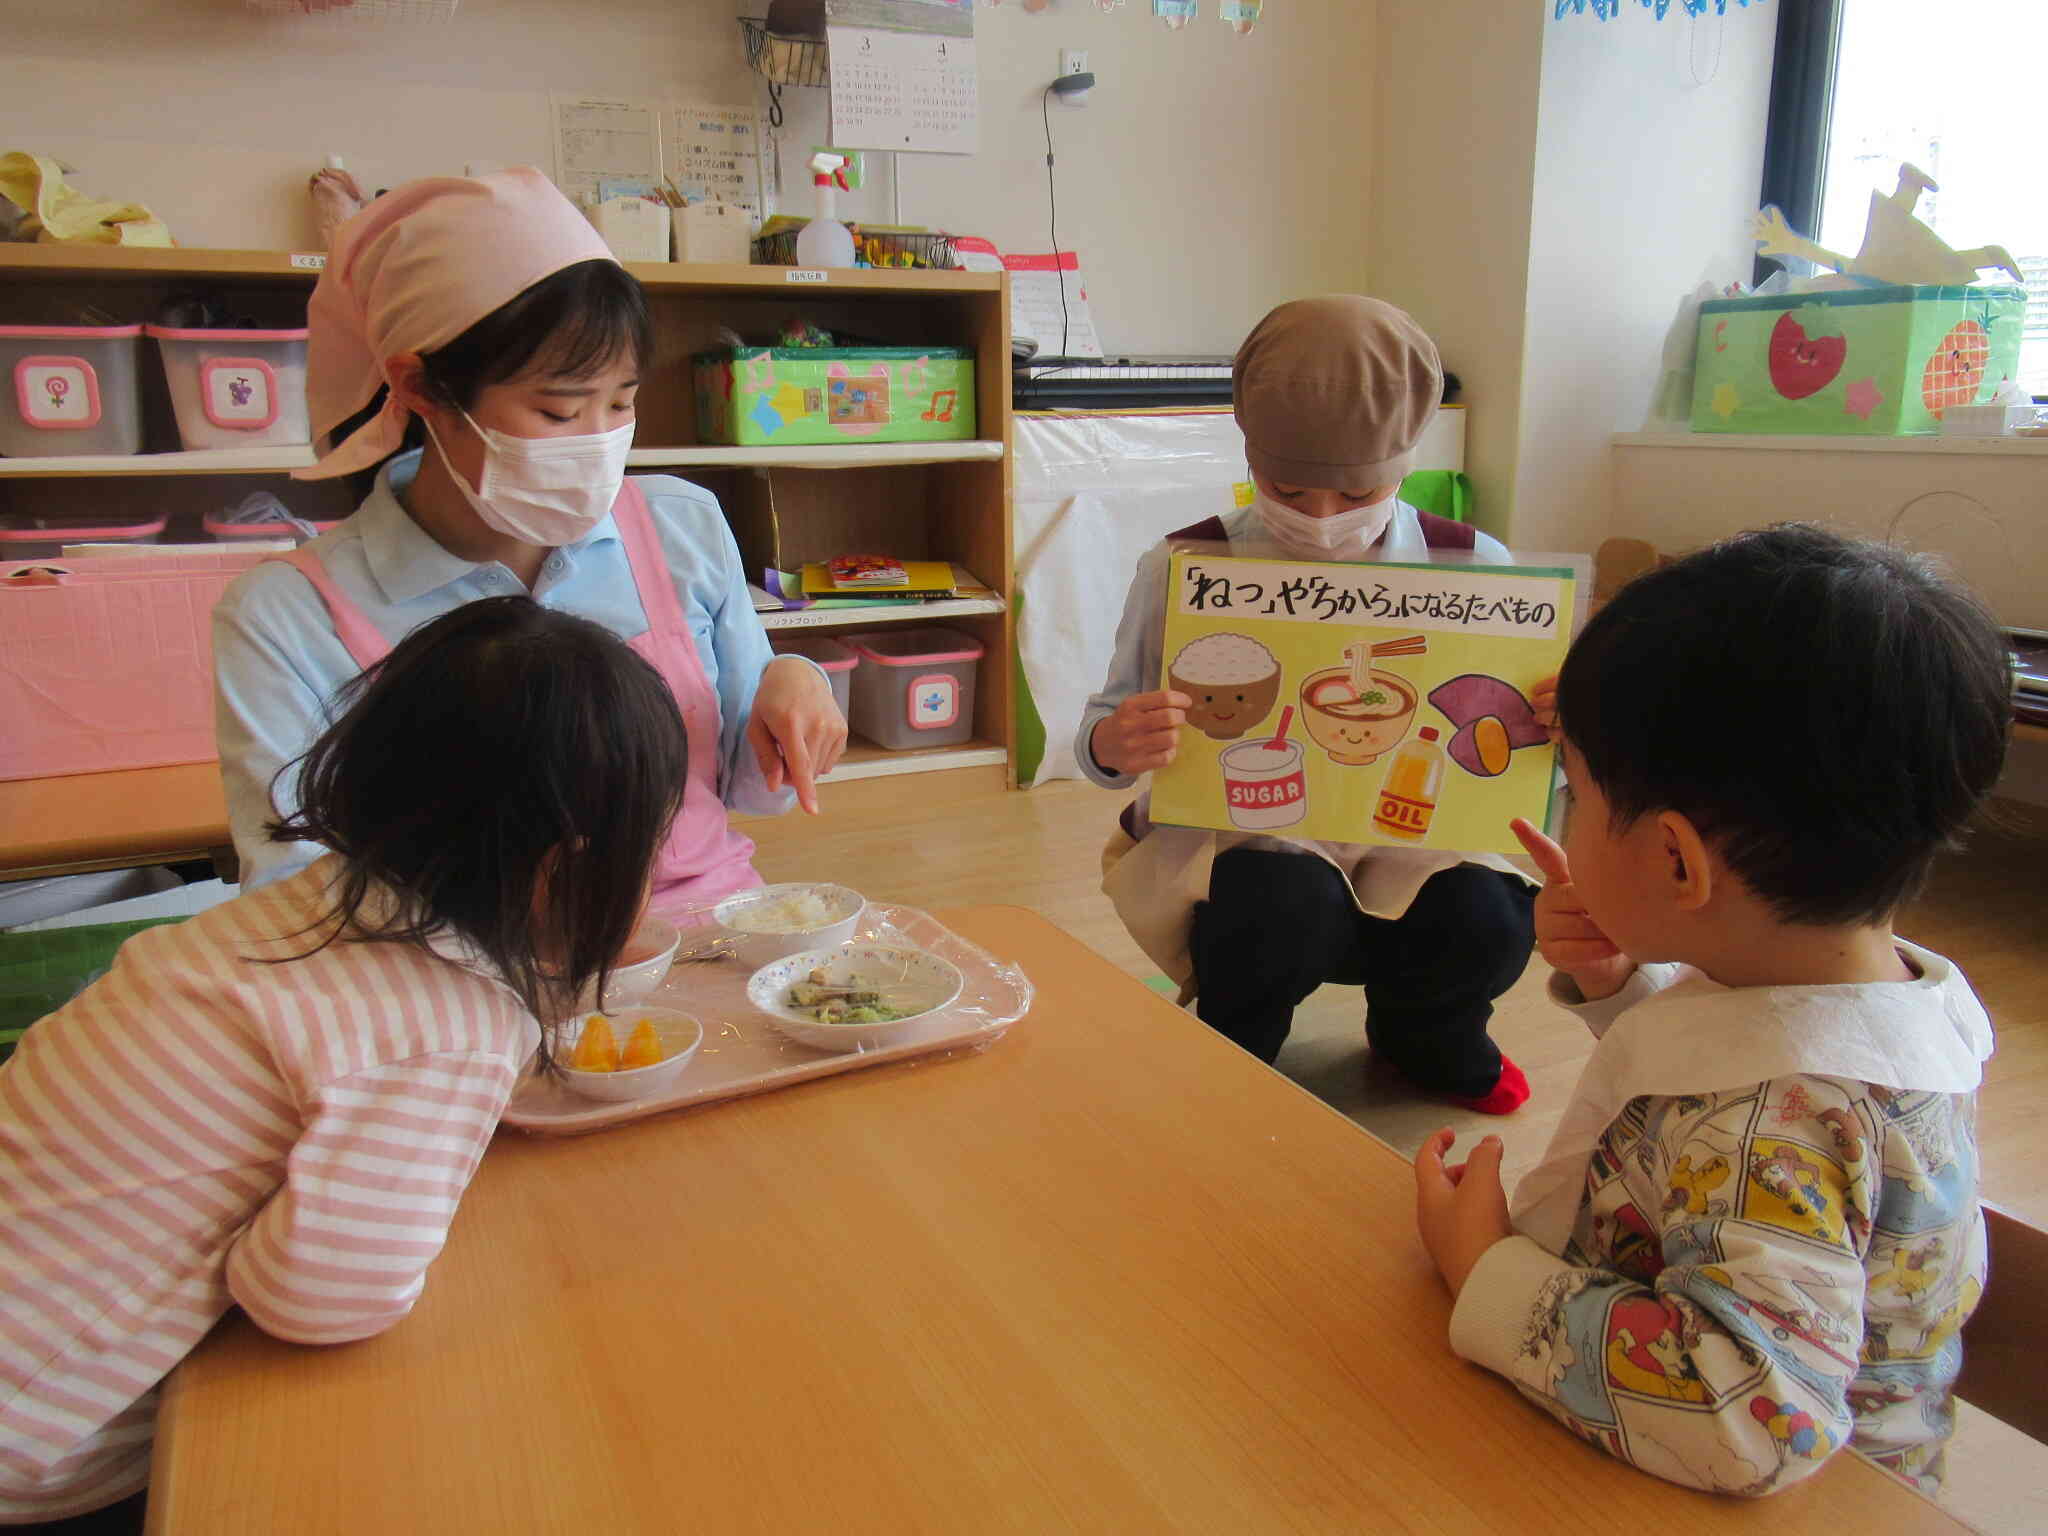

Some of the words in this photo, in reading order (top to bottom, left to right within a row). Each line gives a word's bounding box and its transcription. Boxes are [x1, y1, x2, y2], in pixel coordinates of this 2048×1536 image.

[862, 36, 871, 51] 3
[937, 42, 946, 57] 4
[1231, 781, 1300, 804] SUGAR
[1381, 800, 1425, 826] OIL
